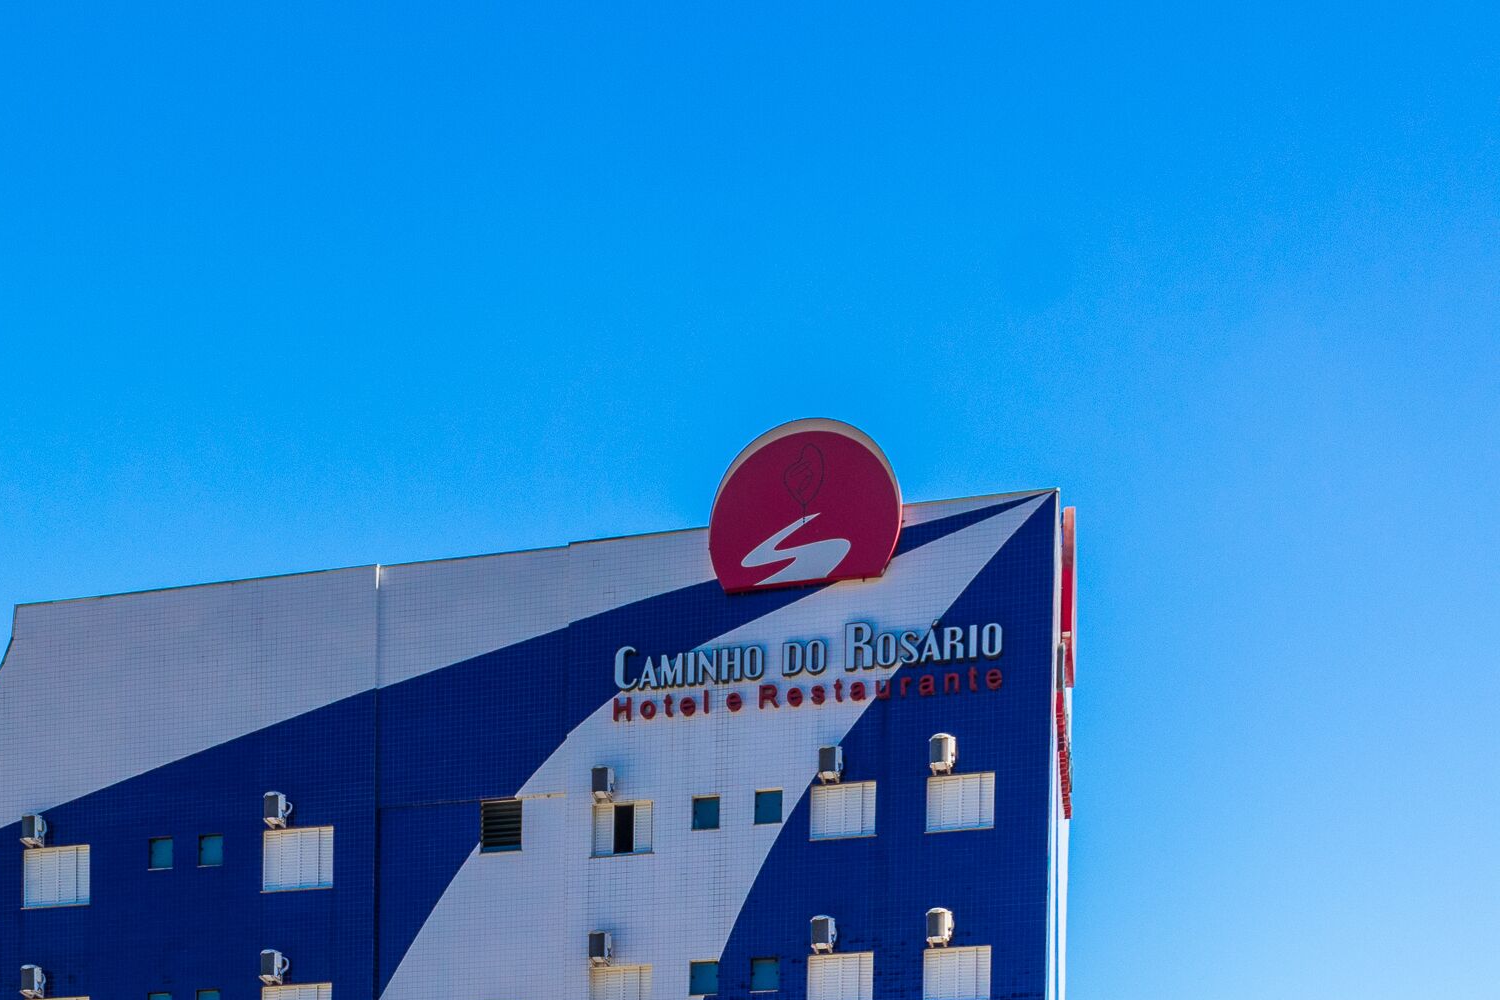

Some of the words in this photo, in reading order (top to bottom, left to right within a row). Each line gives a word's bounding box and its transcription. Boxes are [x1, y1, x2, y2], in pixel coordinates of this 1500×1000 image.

[613, 645, 764, 691] CAMINHO
[782, 638, 827, 677] DO
[844, 618, 1004, 672] ROSÁRIO
[611, 689, 710, 722] Hotel
[725, 692, 743, 712] e
[757, 667, 1003, 710] Restaurante
